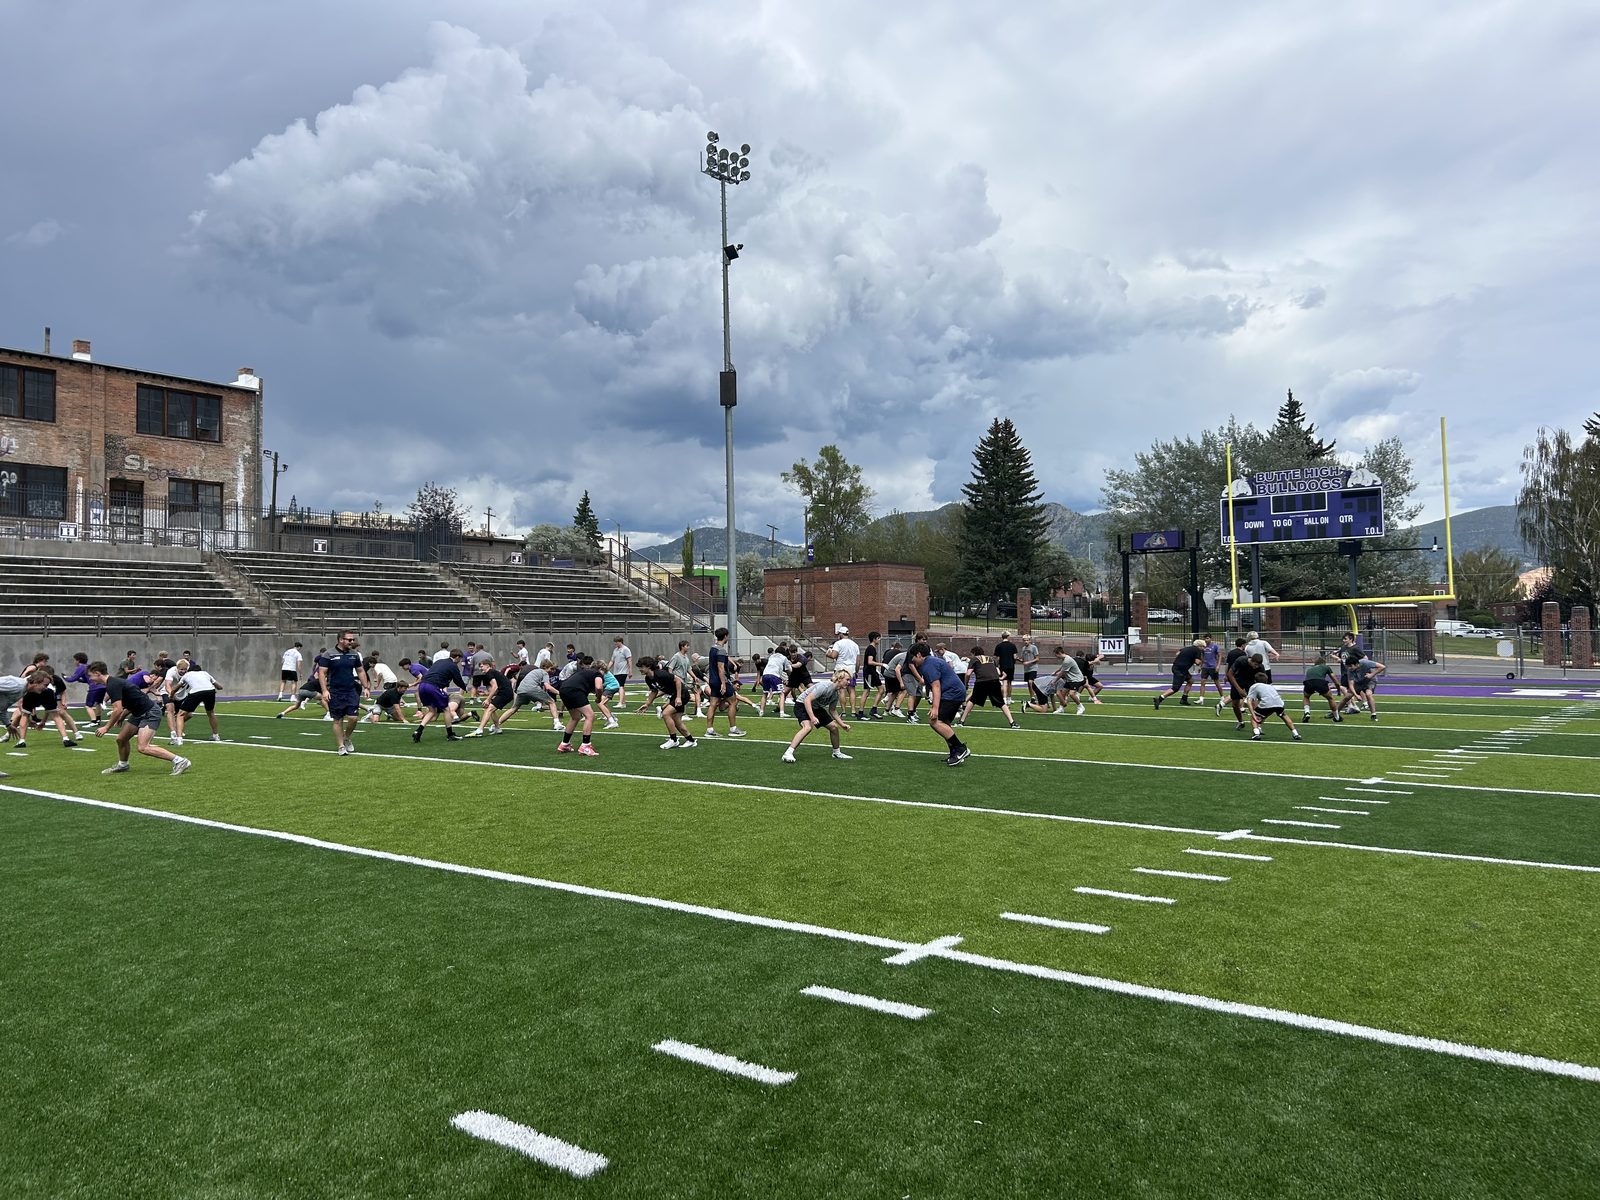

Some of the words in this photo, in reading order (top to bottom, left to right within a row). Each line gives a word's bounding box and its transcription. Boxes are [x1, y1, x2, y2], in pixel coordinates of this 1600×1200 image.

[1256, 469, 1300, 482] BUTTE
[1304, 466, 1339, 479] HIGH
[1256, 478, 1342, 495] BULLDOGS
[1282, 519, 1293, 527] GO
[1303, 517, 1319, 525] BALL
[1320, 516, 1329, 524] ON
[1339, 515, 1353, 523] QTR
[1244, 521, 1265, 529] DOWN
[1100, 639, 1123, 650] TNT
